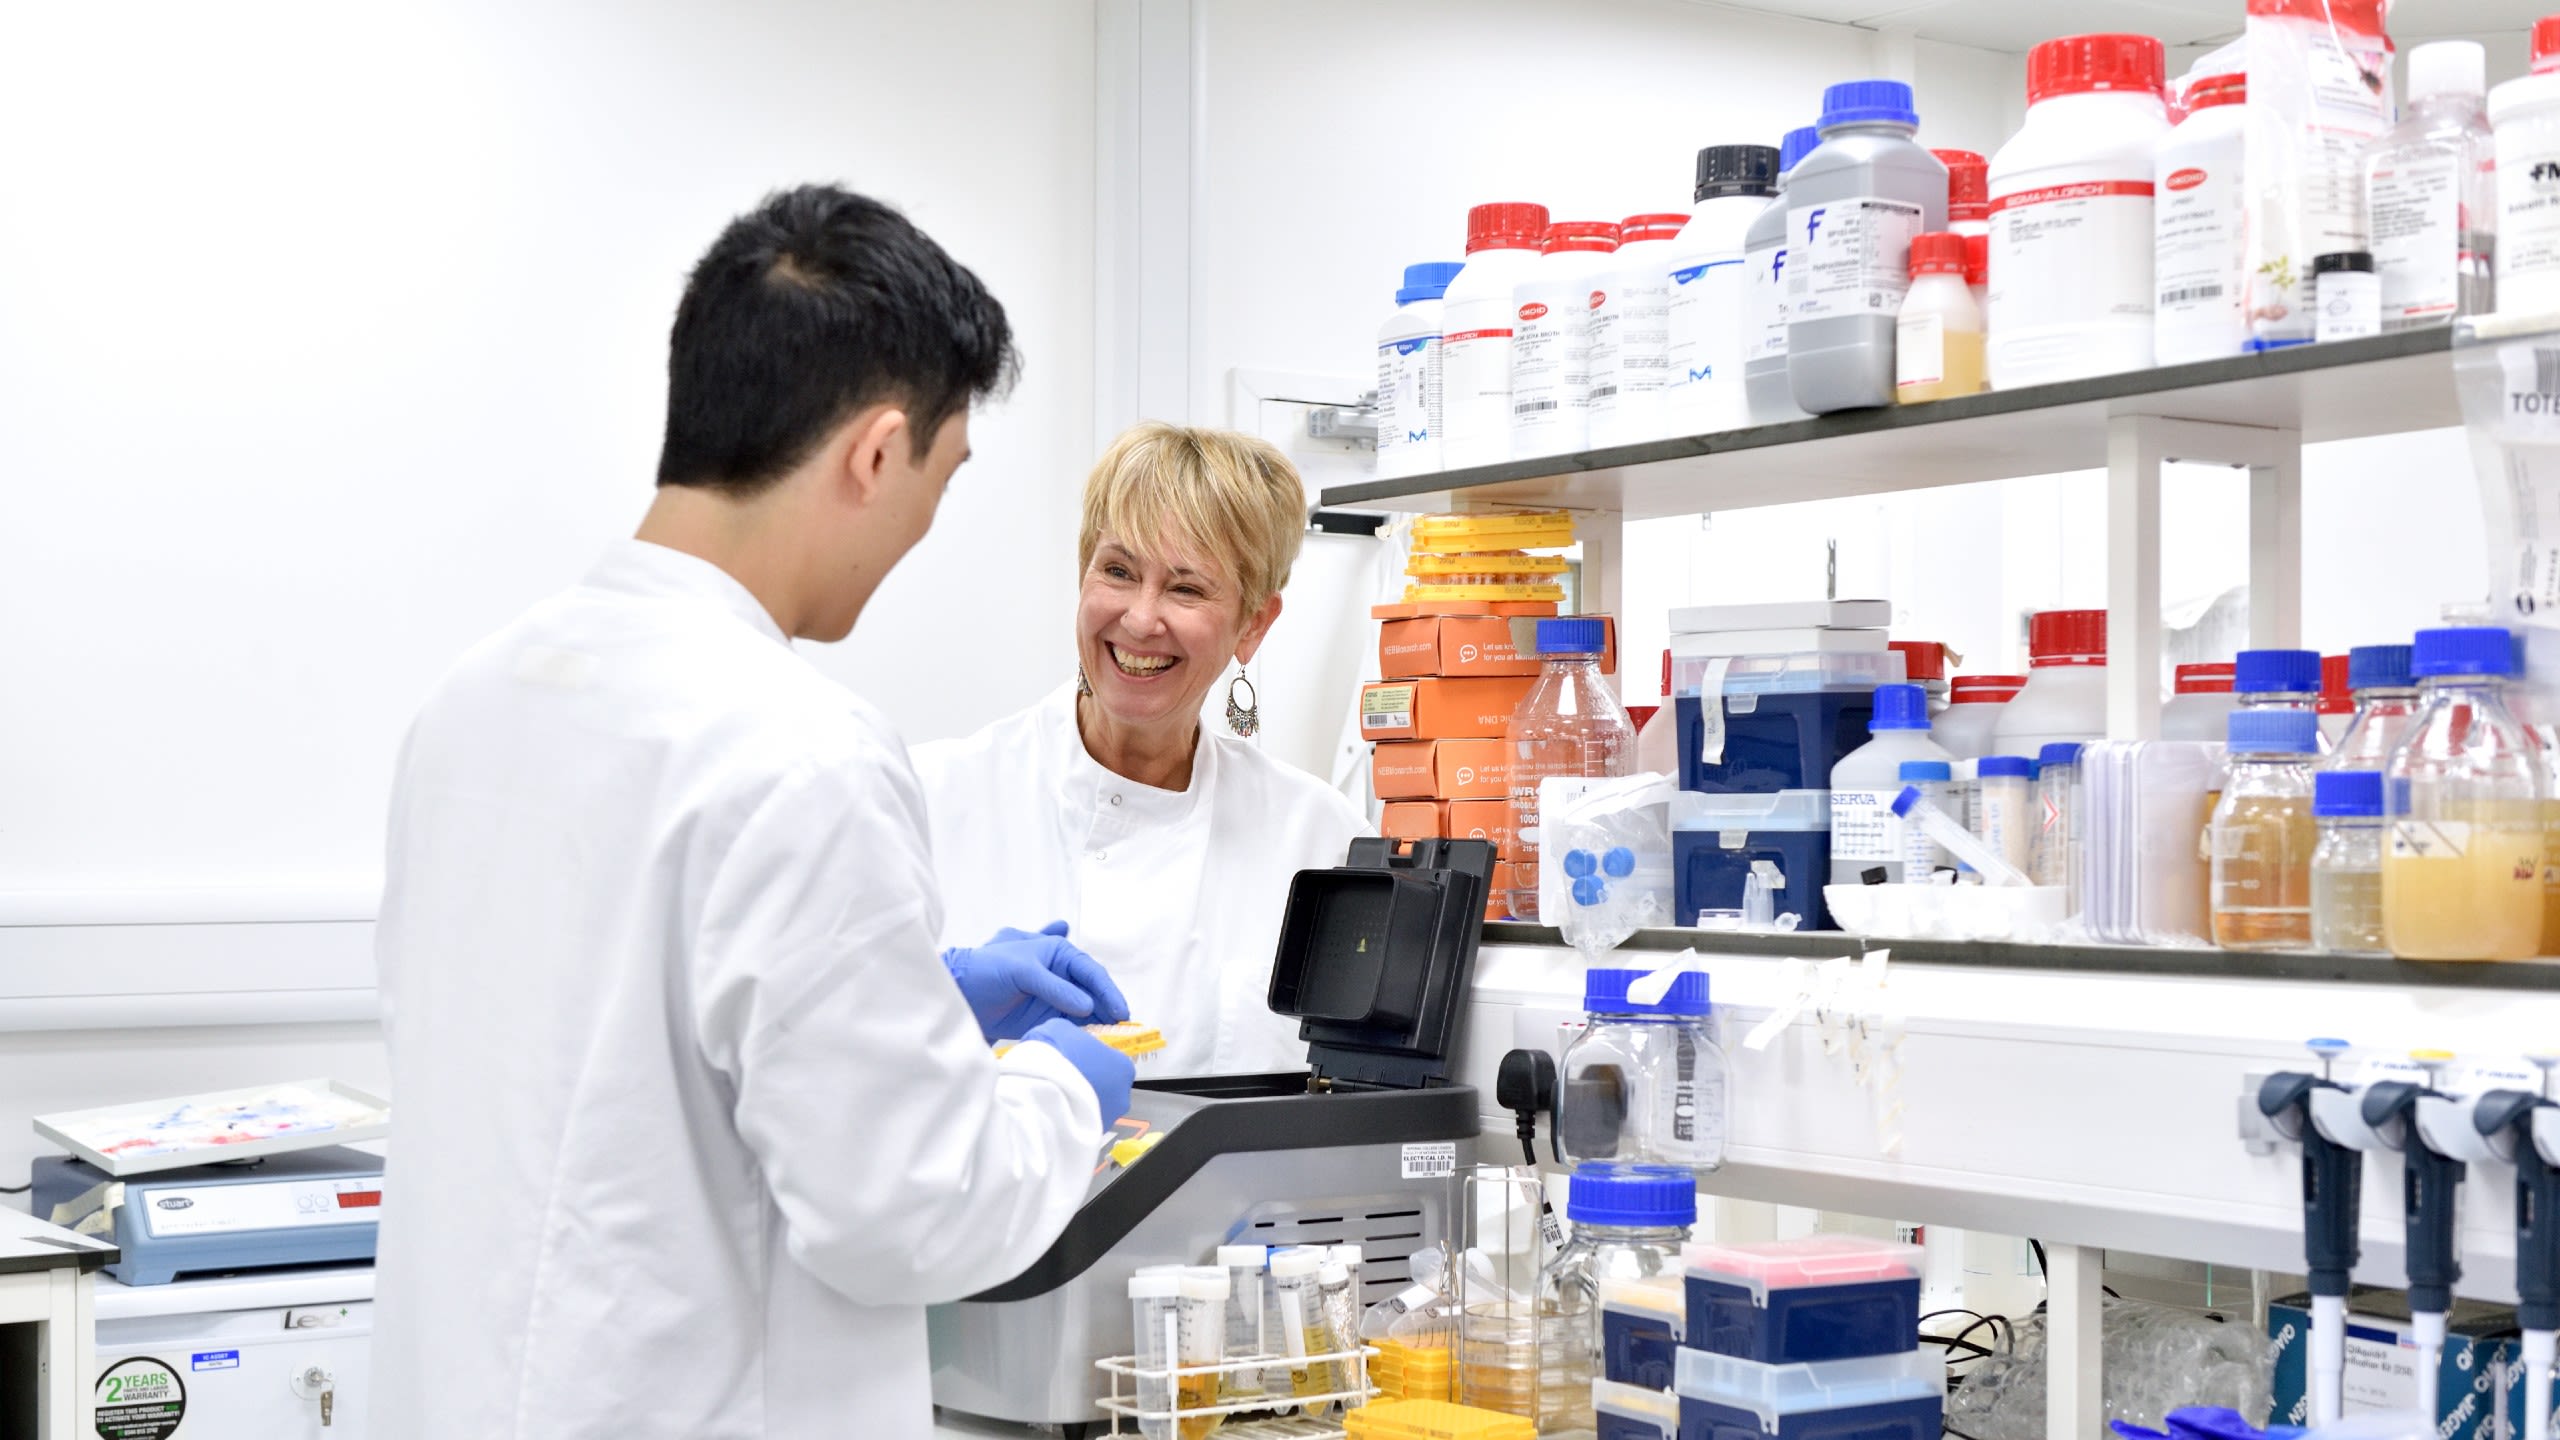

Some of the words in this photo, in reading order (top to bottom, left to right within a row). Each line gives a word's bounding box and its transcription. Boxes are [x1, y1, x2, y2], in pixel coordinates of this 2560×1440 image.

[2006, 183, 2104, 208] SIGMA-ALDRICH
[1519, 306, 1546, 317] OXOID
[1384, 643, 1432, 655] NEBMonarch.com
[1478, 715, 1498, 724] DNA
[1509, 786, 1534, 796] VWR
[1832, 793, 1877, 805] SERVA
[1520, 814, 1538, 824] 1000
[159, 1199, 191, 1209] stuart
[106, 1376, 122, 1402] 2
[124, 1373, 168, 1387] YEARS
[124, 1391, 169, 1401] WARRANTY
[139, 1405, 164, 1413] PRODUCT
[147, 1410, 180, 1419] WARRANTY!
